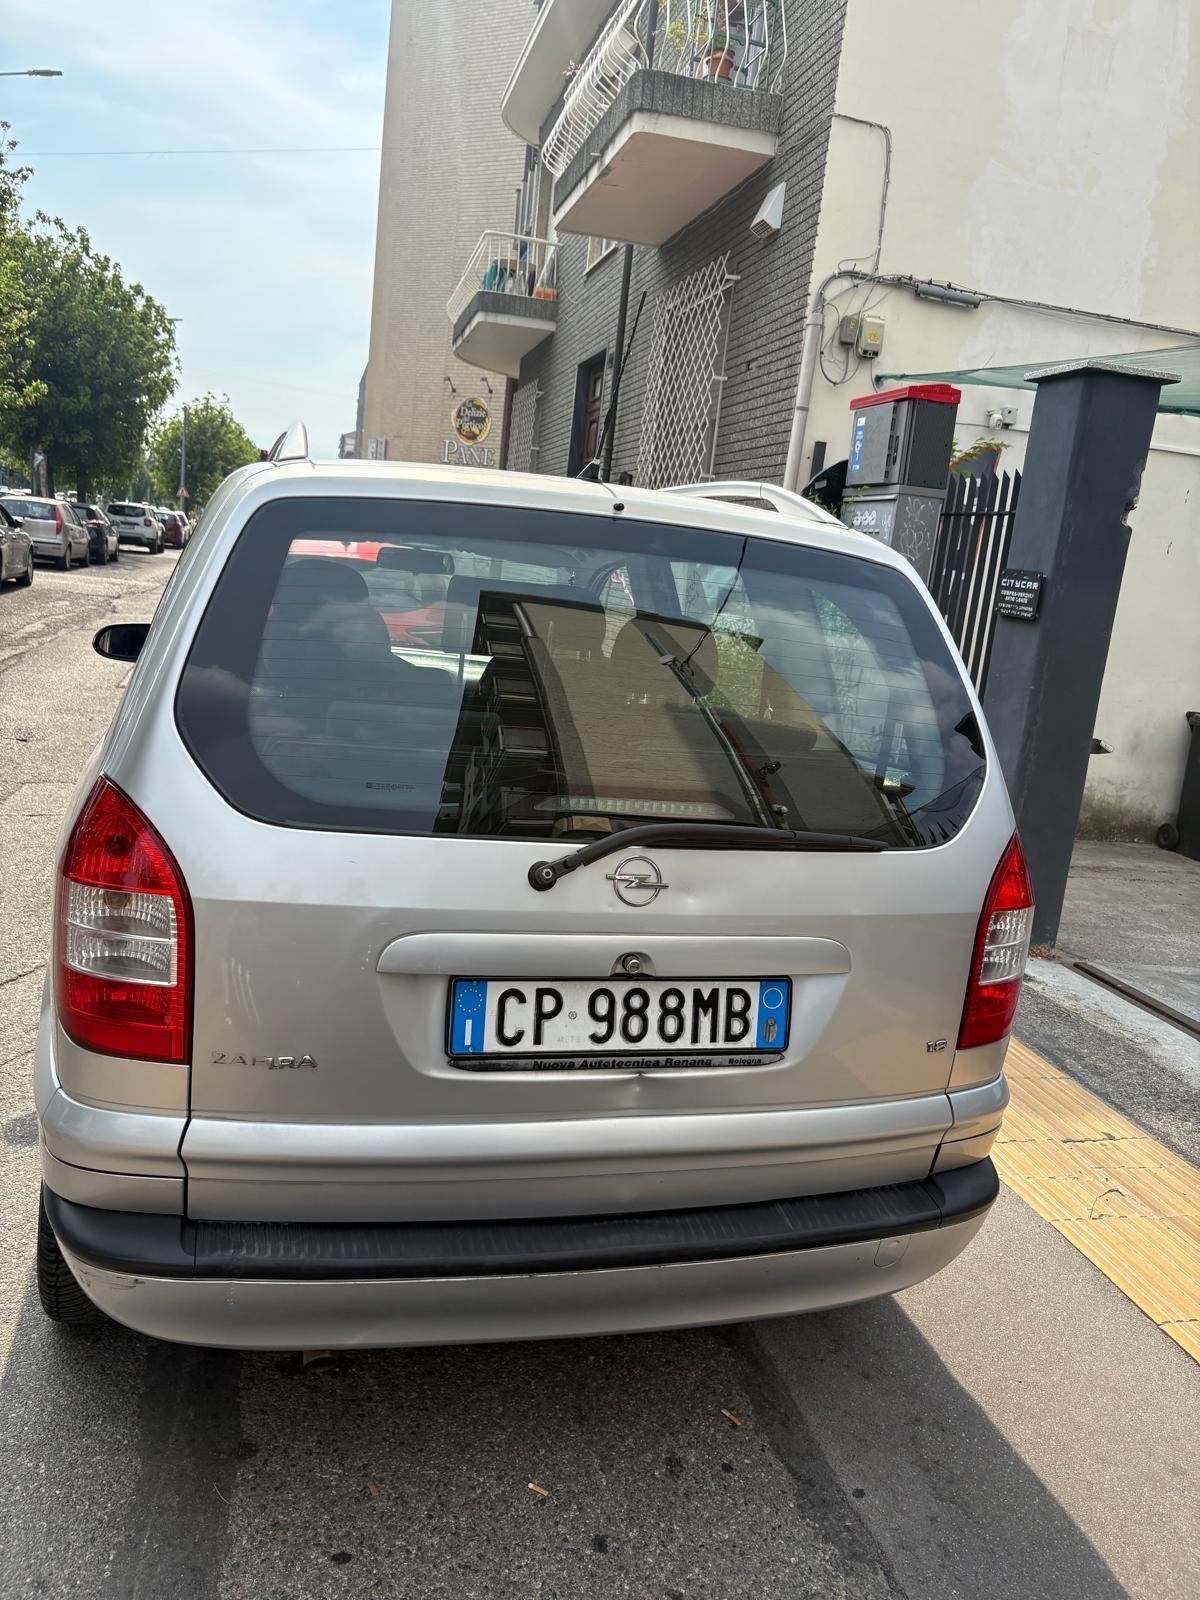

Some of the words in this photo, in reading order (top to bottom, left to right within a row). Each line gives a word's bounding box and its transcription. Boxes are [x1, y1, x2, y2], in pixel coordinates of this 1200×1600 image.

[441, 439, 495, 466] PANE
[1001, 578, 1039, 590] CITYCAR
[495, 987, 563, 1047] CP
[533, 1060, 576, 1070] Nuova
[579, 1058, 661, 1069] Autotecnica
[664, 1057, 713, 1068] Renana
[728, 1057, 762, 1066] Bologna
